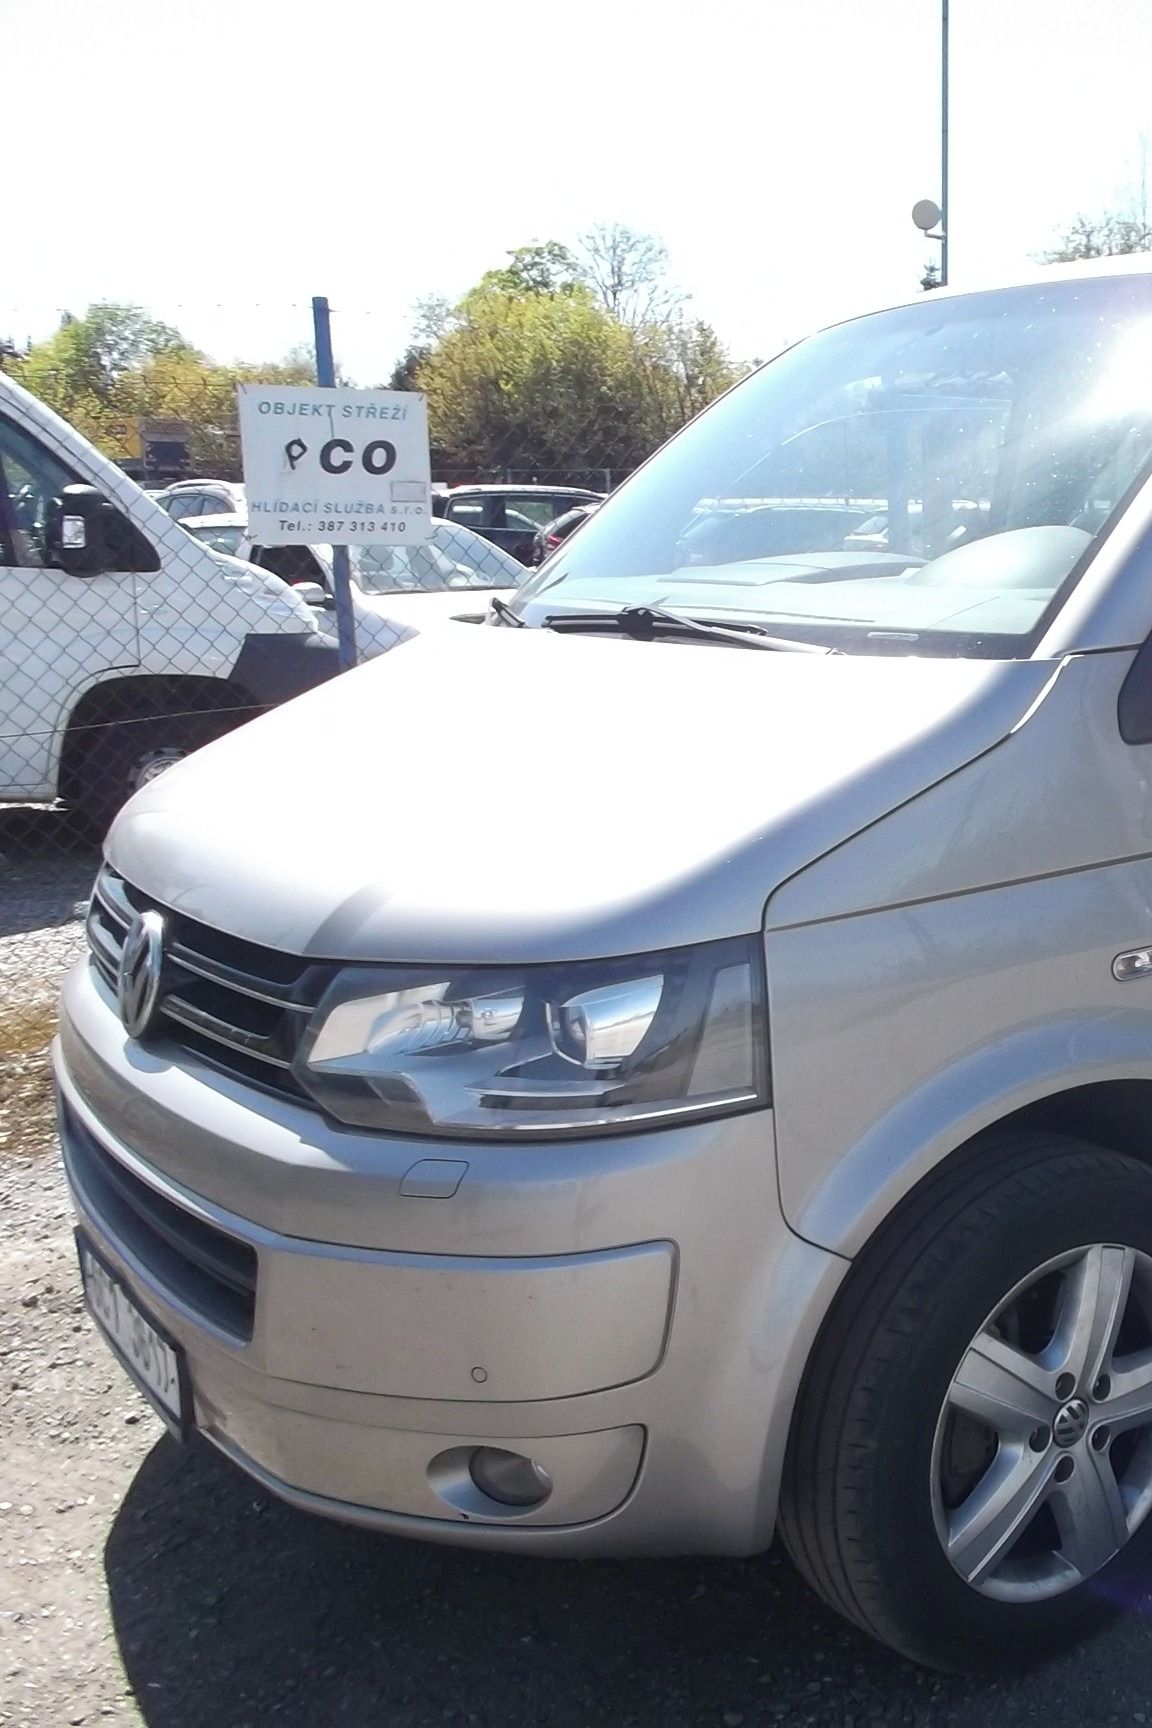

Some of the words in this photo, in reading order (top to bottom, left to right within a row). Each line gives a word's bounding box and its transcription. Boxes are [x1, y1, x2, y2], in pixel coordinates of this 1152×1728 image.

[258, 401, 335, 417] OBJEKT
[342, 403, 408, 420] STŘEŽÍ
[251, 500, 319, 514] HLÍDACÍ
[324, 501, 385, 515] SLUŽBA
[279, 520, 313, 532] Tel.:
[318, 521, 345, 532] 387
[350, 521, 375, 532] 313
[380, 521, 406, 533] 410
